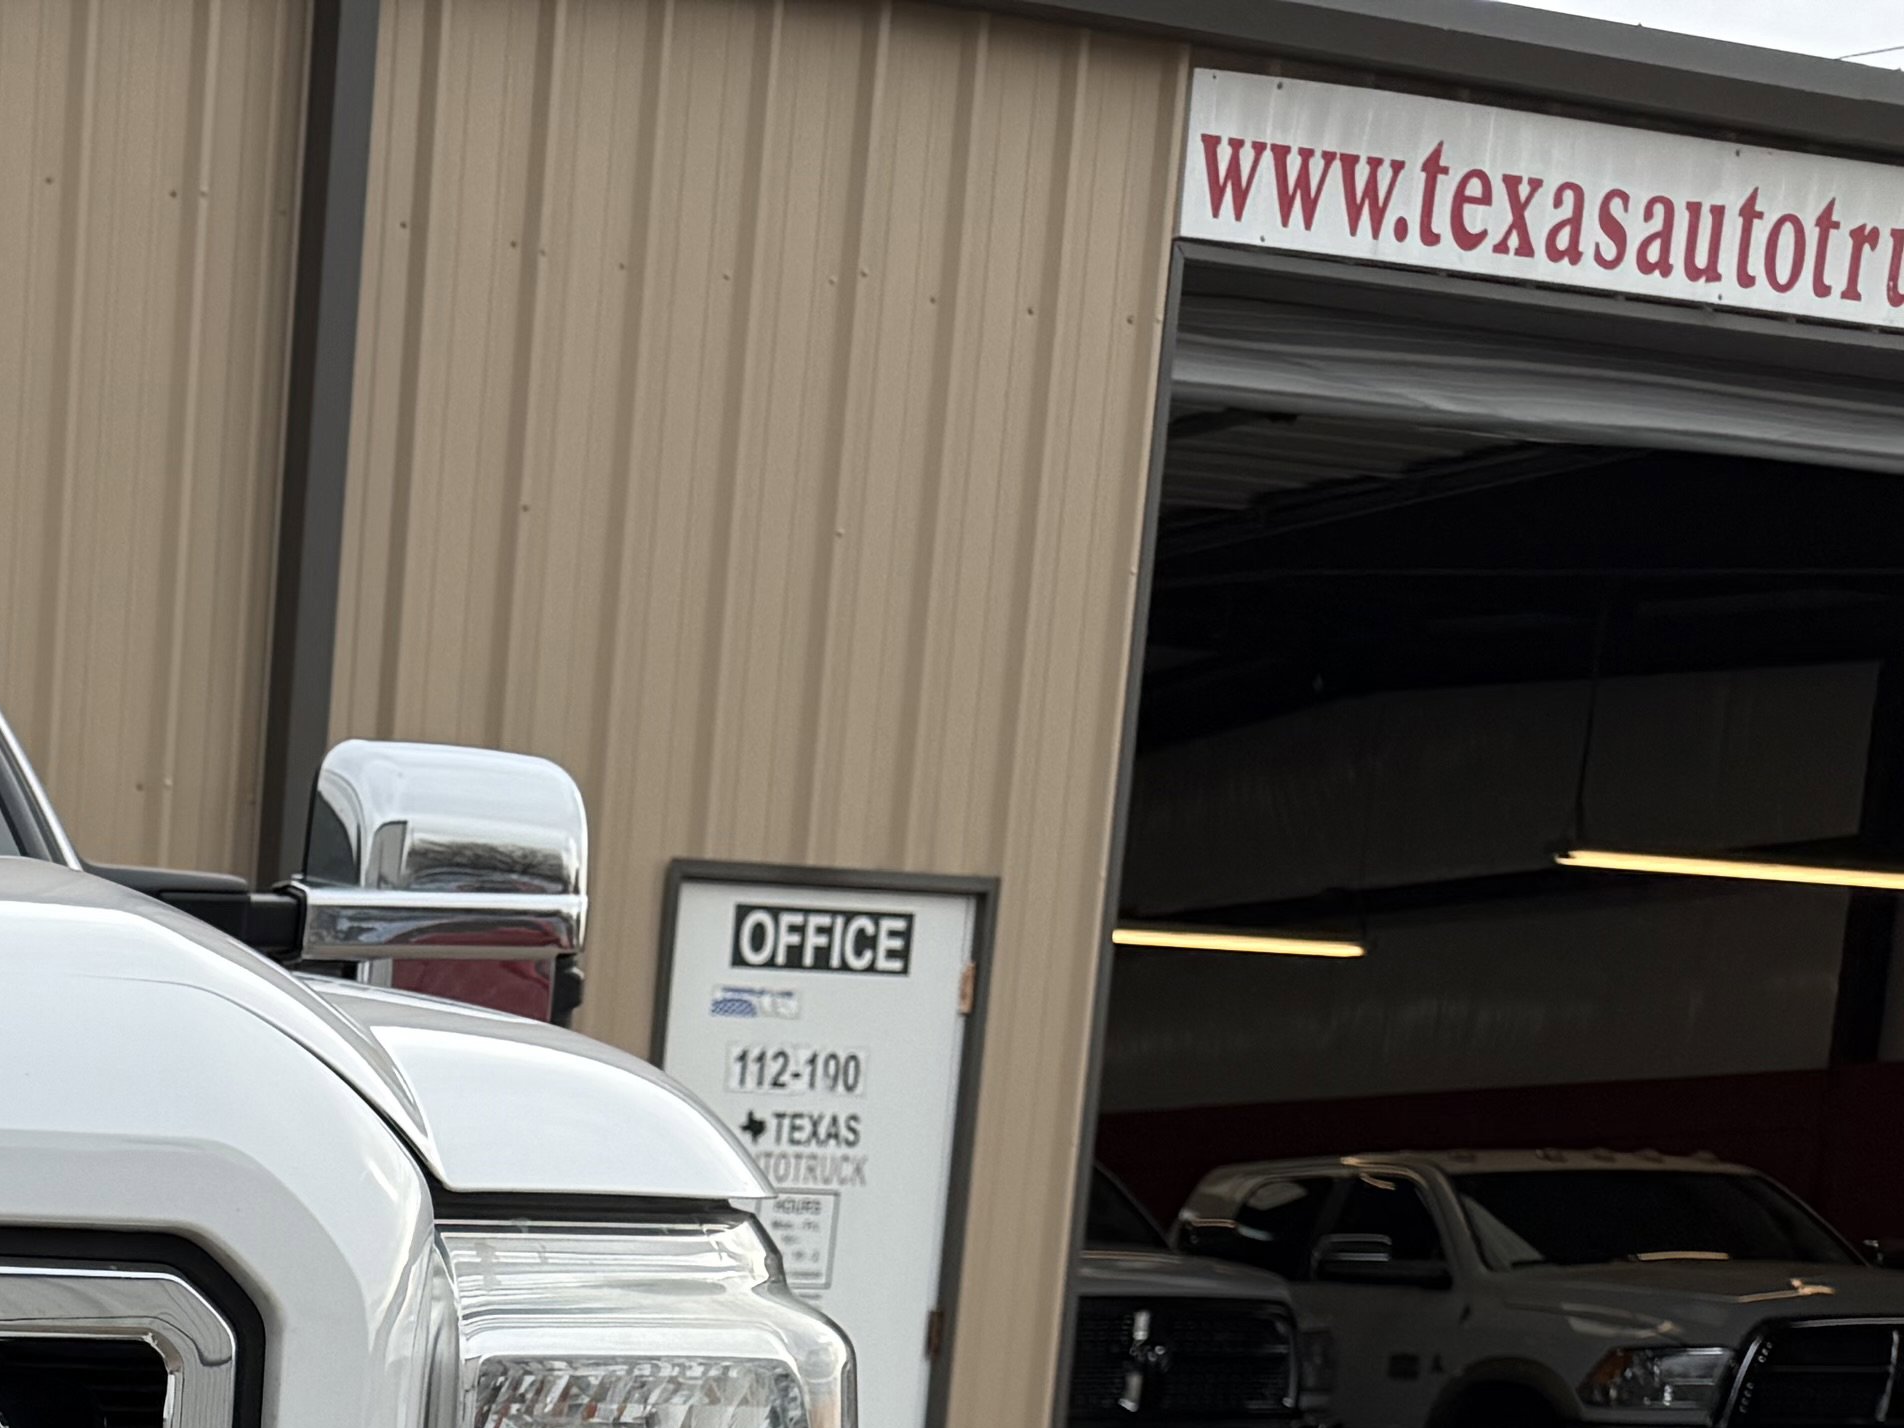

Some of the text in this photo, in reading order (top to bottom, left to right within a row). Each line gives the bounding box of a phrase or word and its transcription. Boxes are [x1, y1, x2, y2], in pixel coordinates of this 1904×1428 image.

[739, 910, 909, 972] OFFICE
[735, 1049, 861, 1093] 112-190
[773, 1112, 862, 1148] TEXAS
[756, 1151, 868, 1187] TOTRUCK
